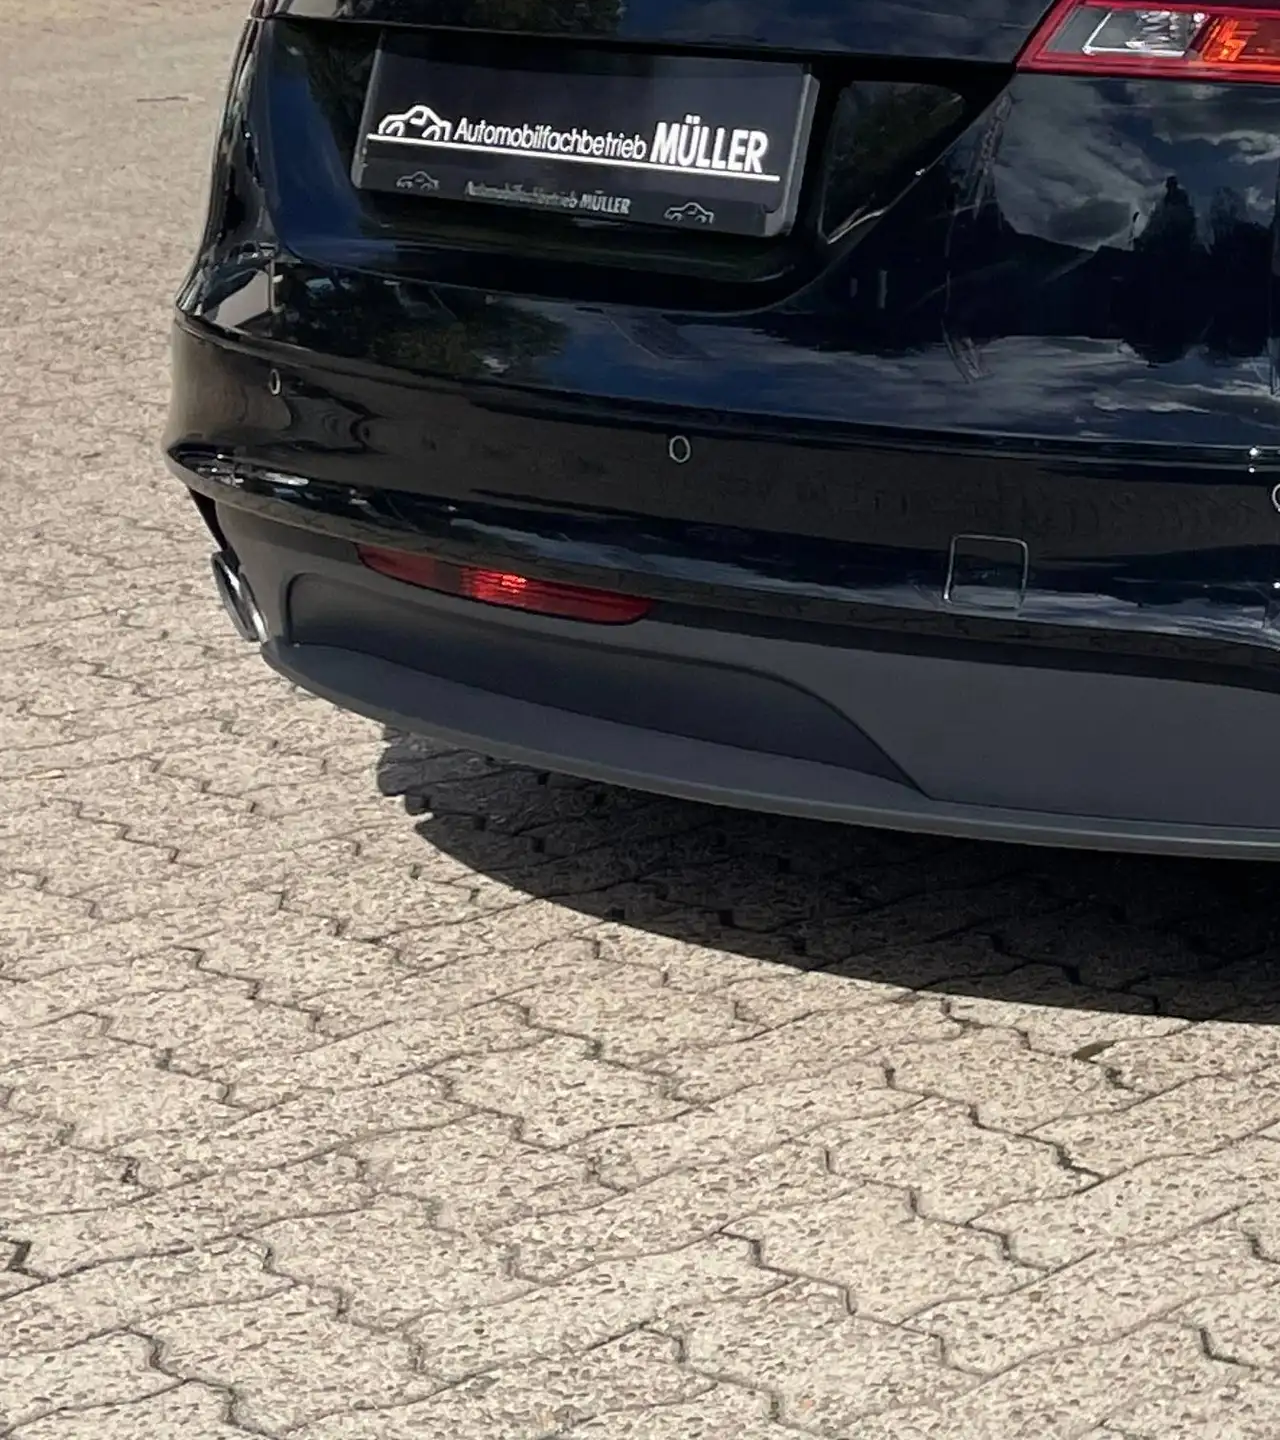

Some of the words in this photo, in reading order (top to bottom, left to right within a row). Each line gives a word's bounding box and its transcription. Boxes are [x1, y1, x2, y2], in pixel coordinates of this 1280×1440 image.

[453, 117, 647, 160] Automobilfachbetrieb
[649, 115, 769, 174] MÜLLER
[579, 190, 632, 215] MÜLLER
